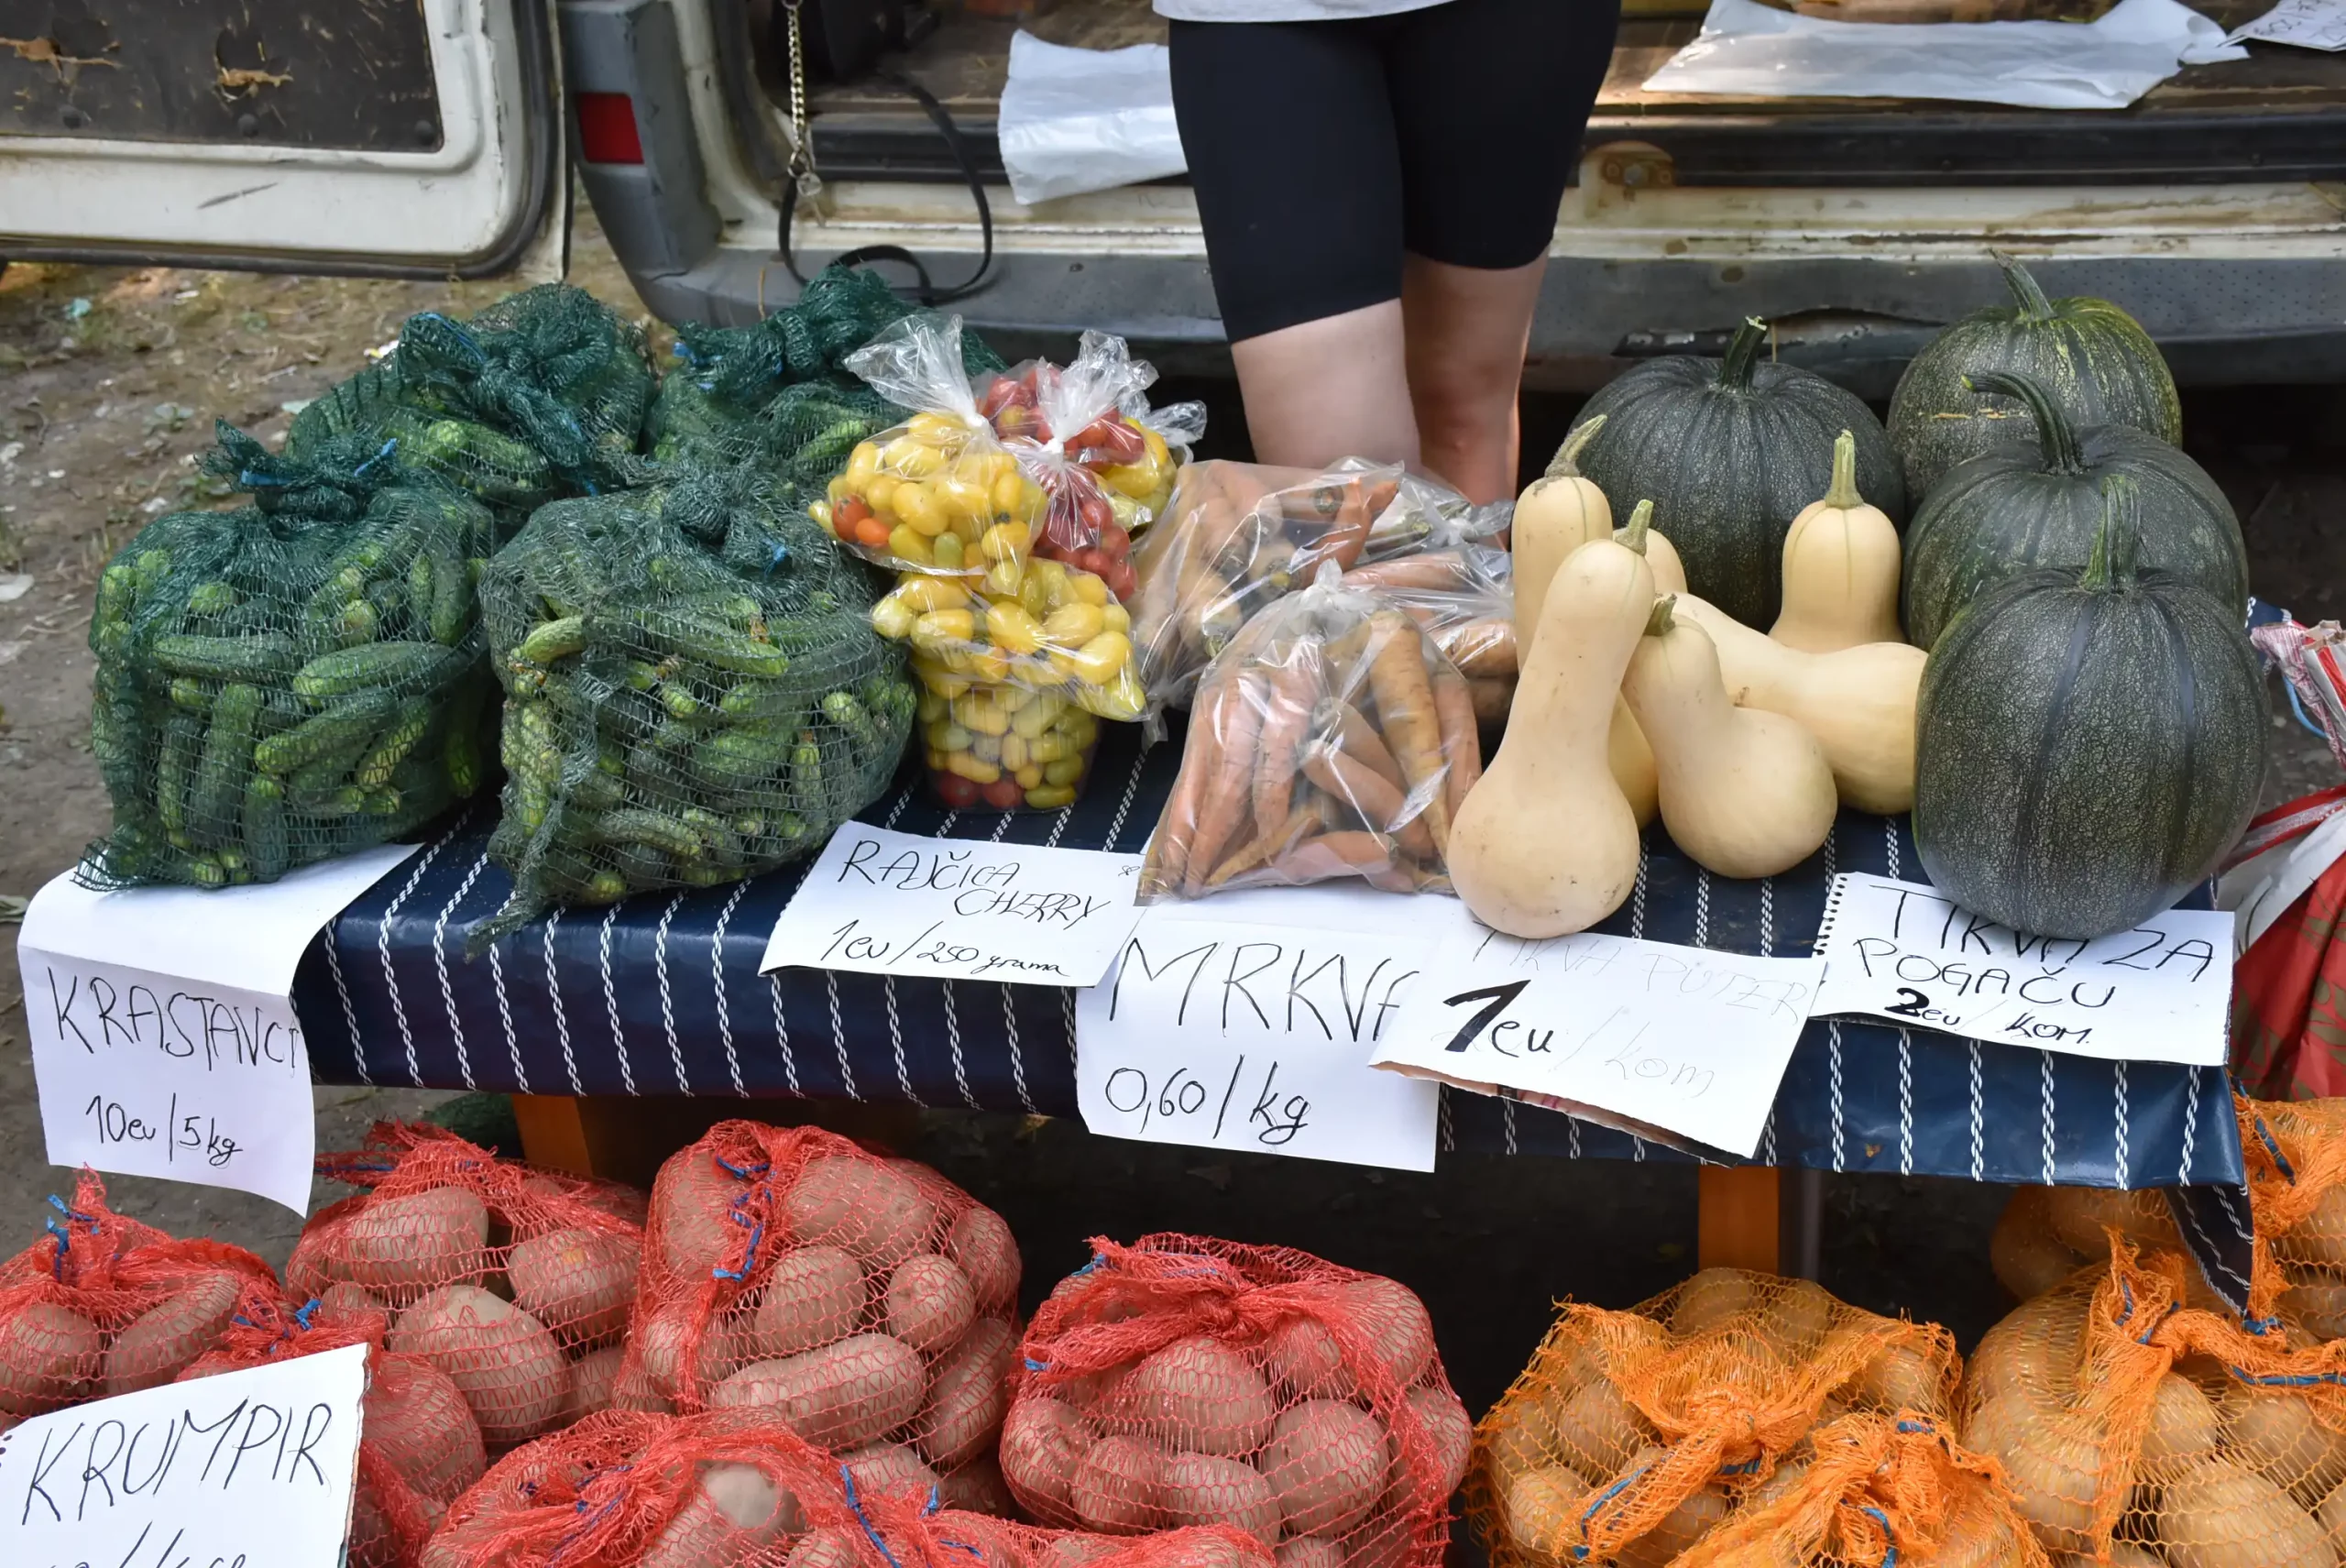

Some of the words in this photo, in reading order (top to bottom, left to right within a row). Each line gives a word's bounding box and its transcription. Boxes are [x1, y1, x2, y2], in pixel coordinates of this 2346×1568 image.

[837, 839, 1021, 891] RAJČICA
[953, 888, 1111, 930] CHERRY
[971, 953, 1070, 977] grama
[1852, 937, 2116, 1009] POGAČU
[2101, 927, 2214, 982] ZA
[21, 1395, 333, 1526] KRUMPIR
